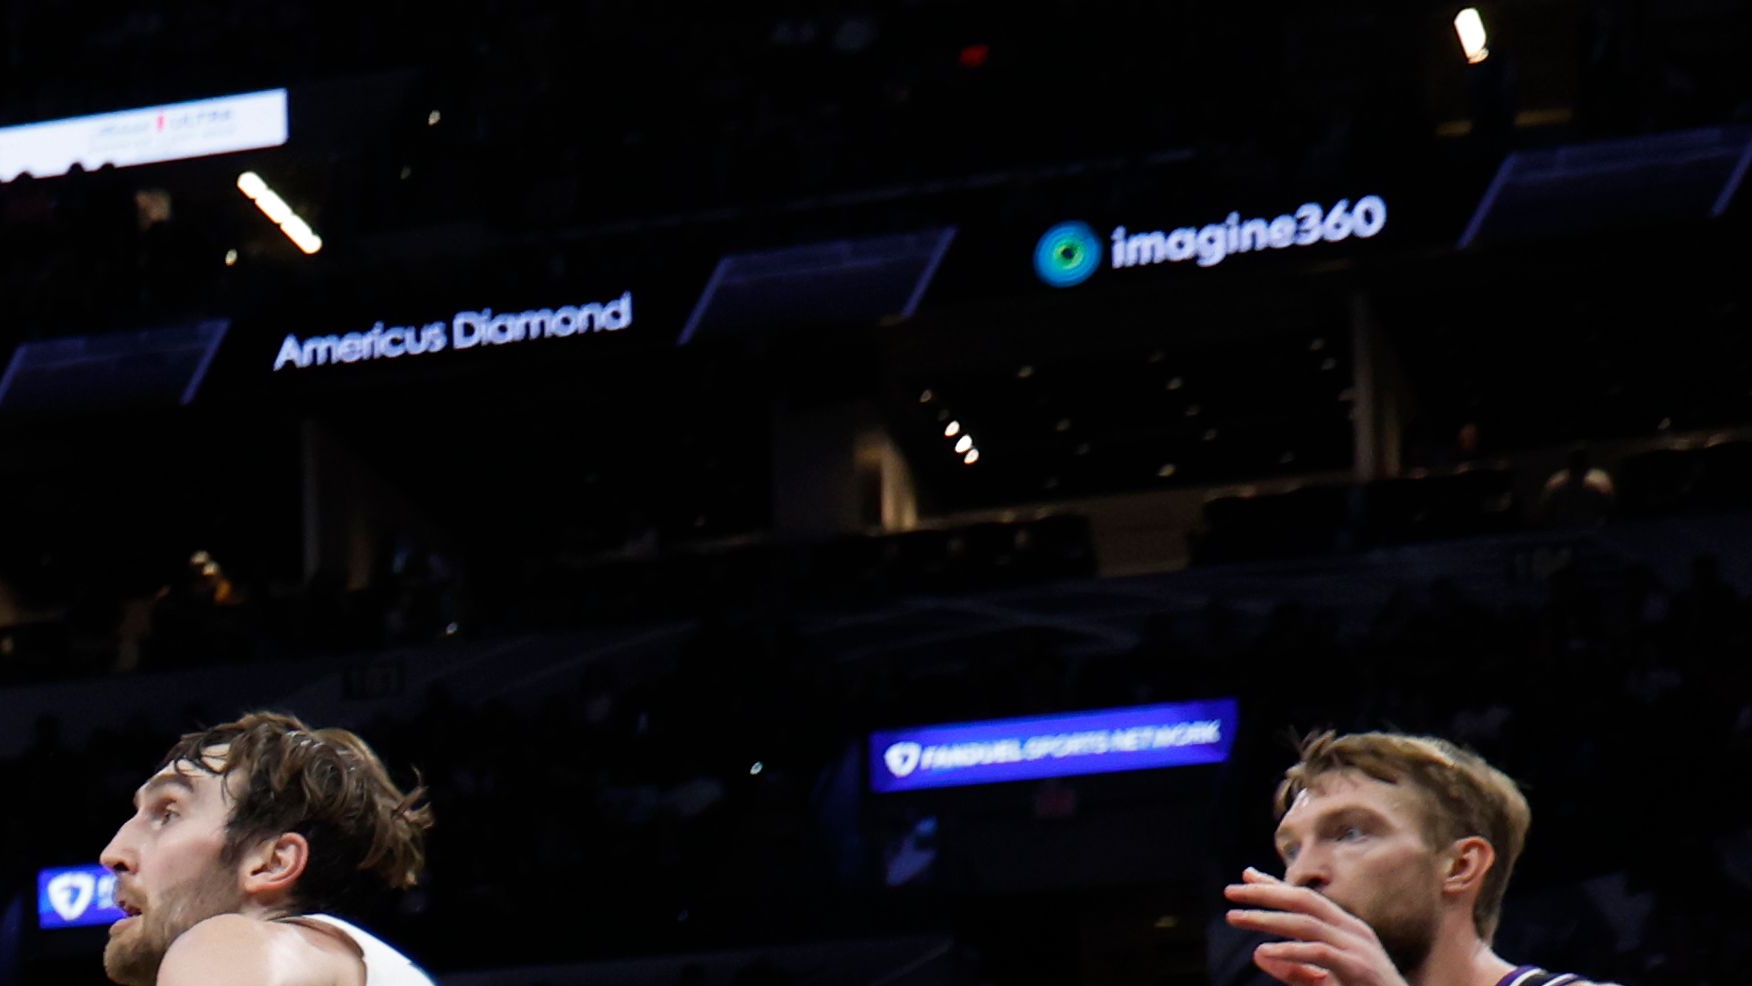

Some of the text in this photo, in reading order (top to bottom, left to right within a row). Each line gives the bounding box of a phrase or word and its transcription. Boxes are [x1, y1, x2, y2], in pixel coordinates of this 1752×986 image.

[1111, 194, 1387, 269] imagine360
[273, 290, 633, 371] Americus Diamond
